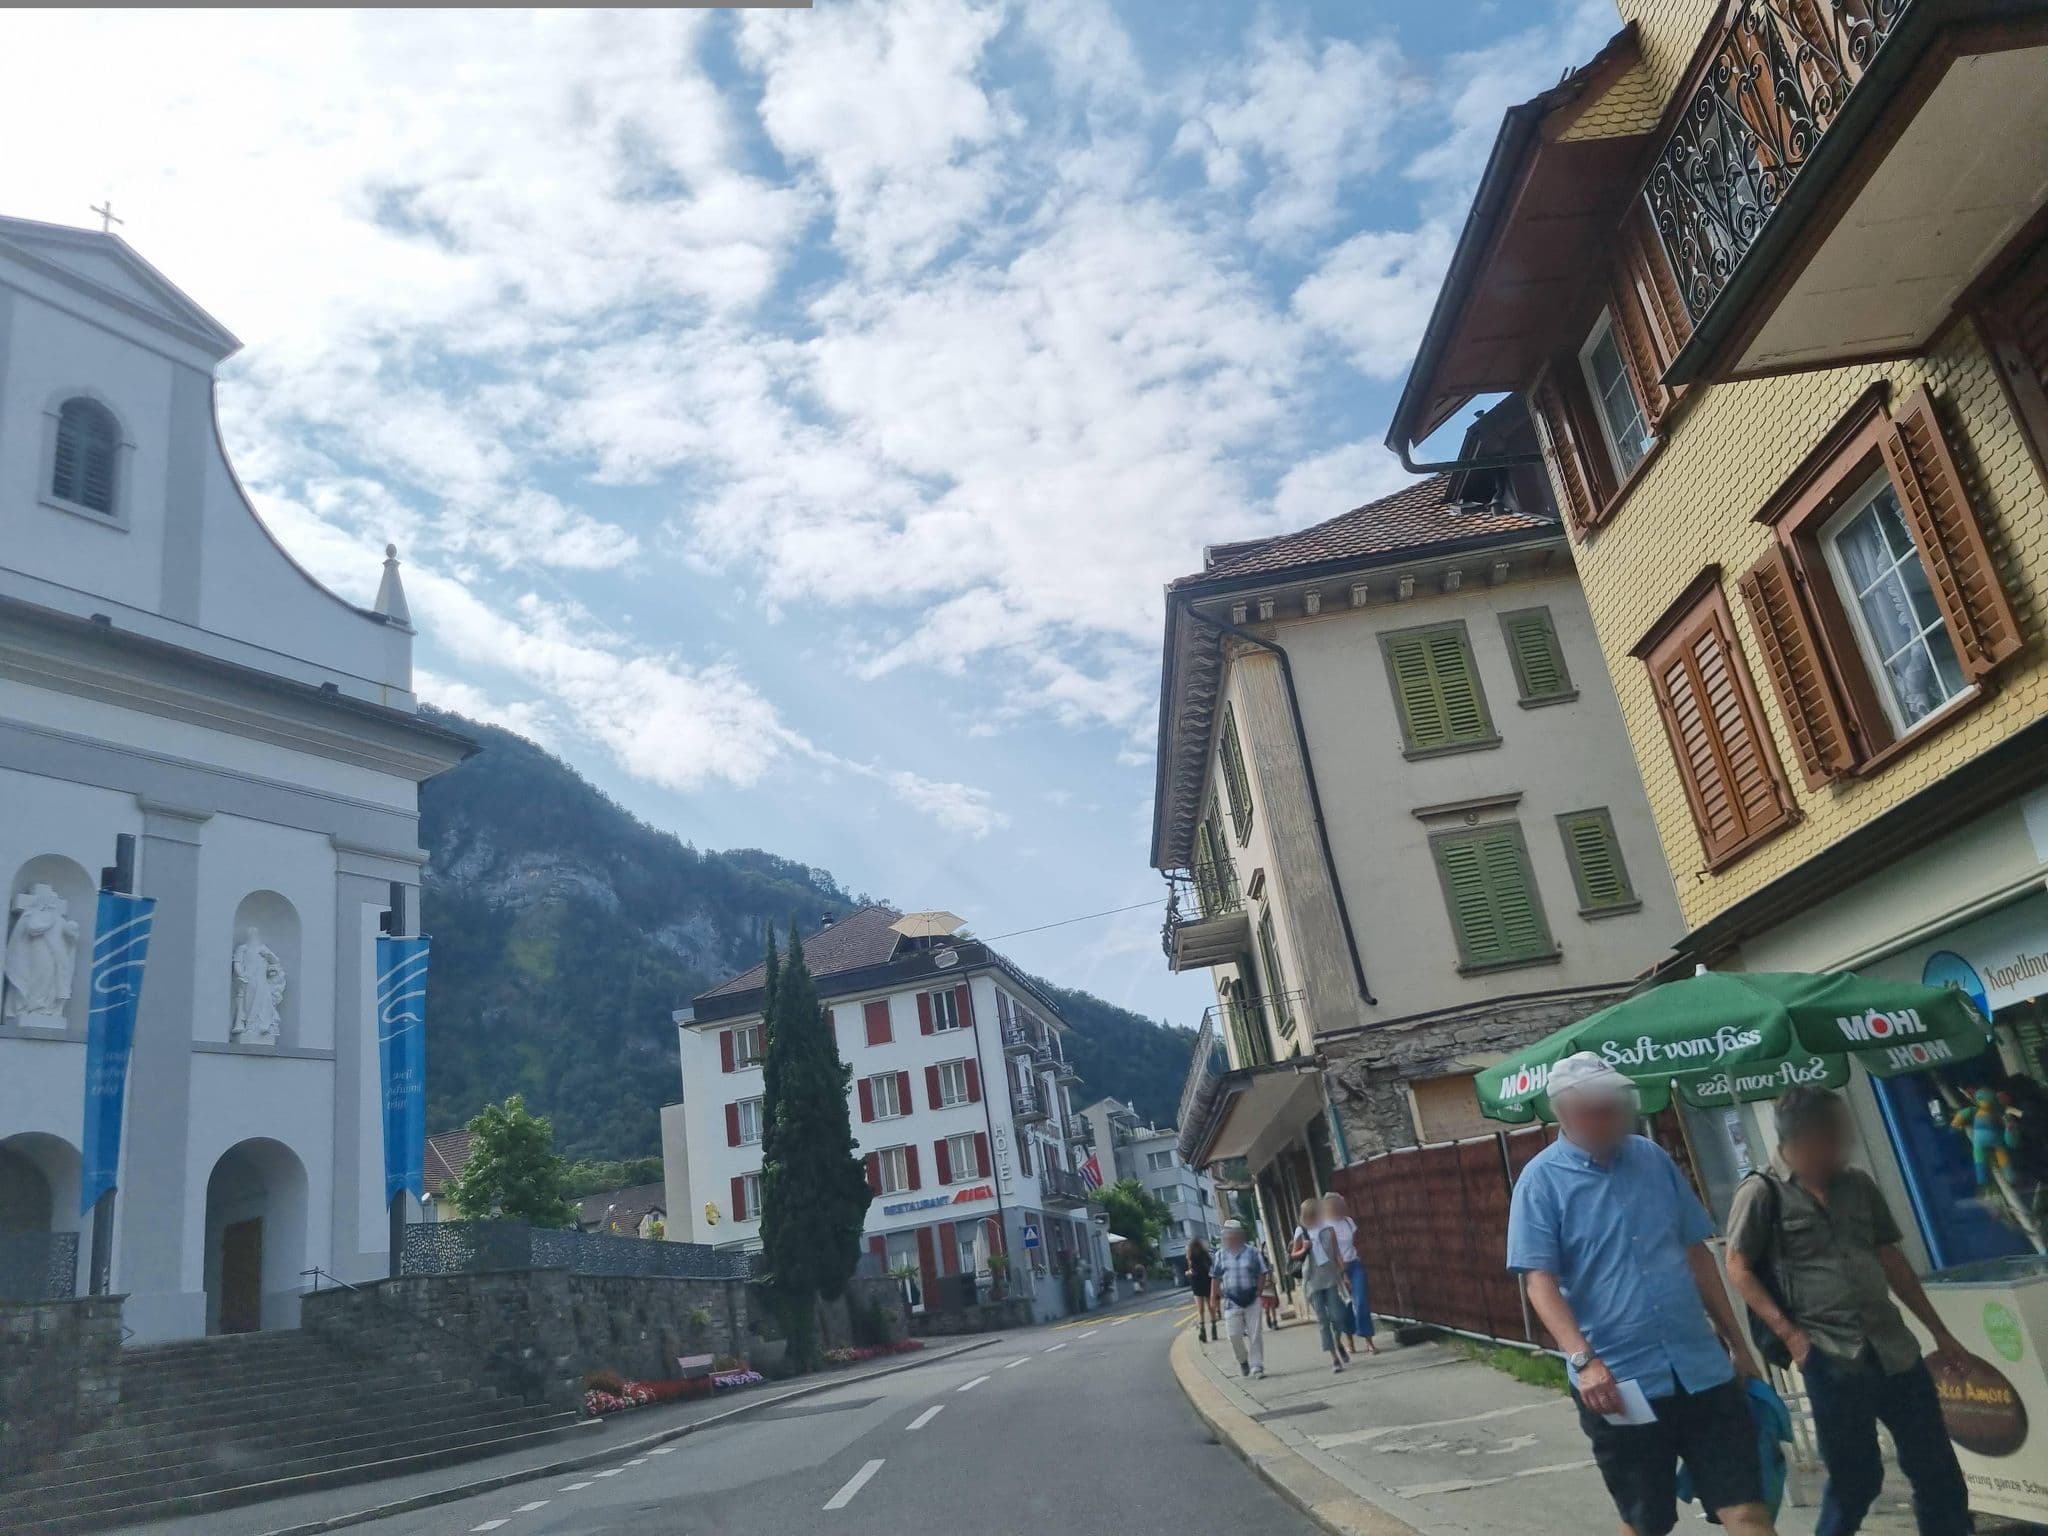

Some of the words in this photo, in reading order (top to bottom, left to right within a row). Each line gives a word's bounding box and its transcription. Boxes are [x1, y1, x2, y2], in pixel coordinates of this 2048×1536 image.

[1836, 1007, 1927, 1041] MÖHL
[1601, 1036, 1664, 1066] Saft
[1662, 1037, 1715, 1060] vom
[993, 1121, 1014, 1195] HOTEL
